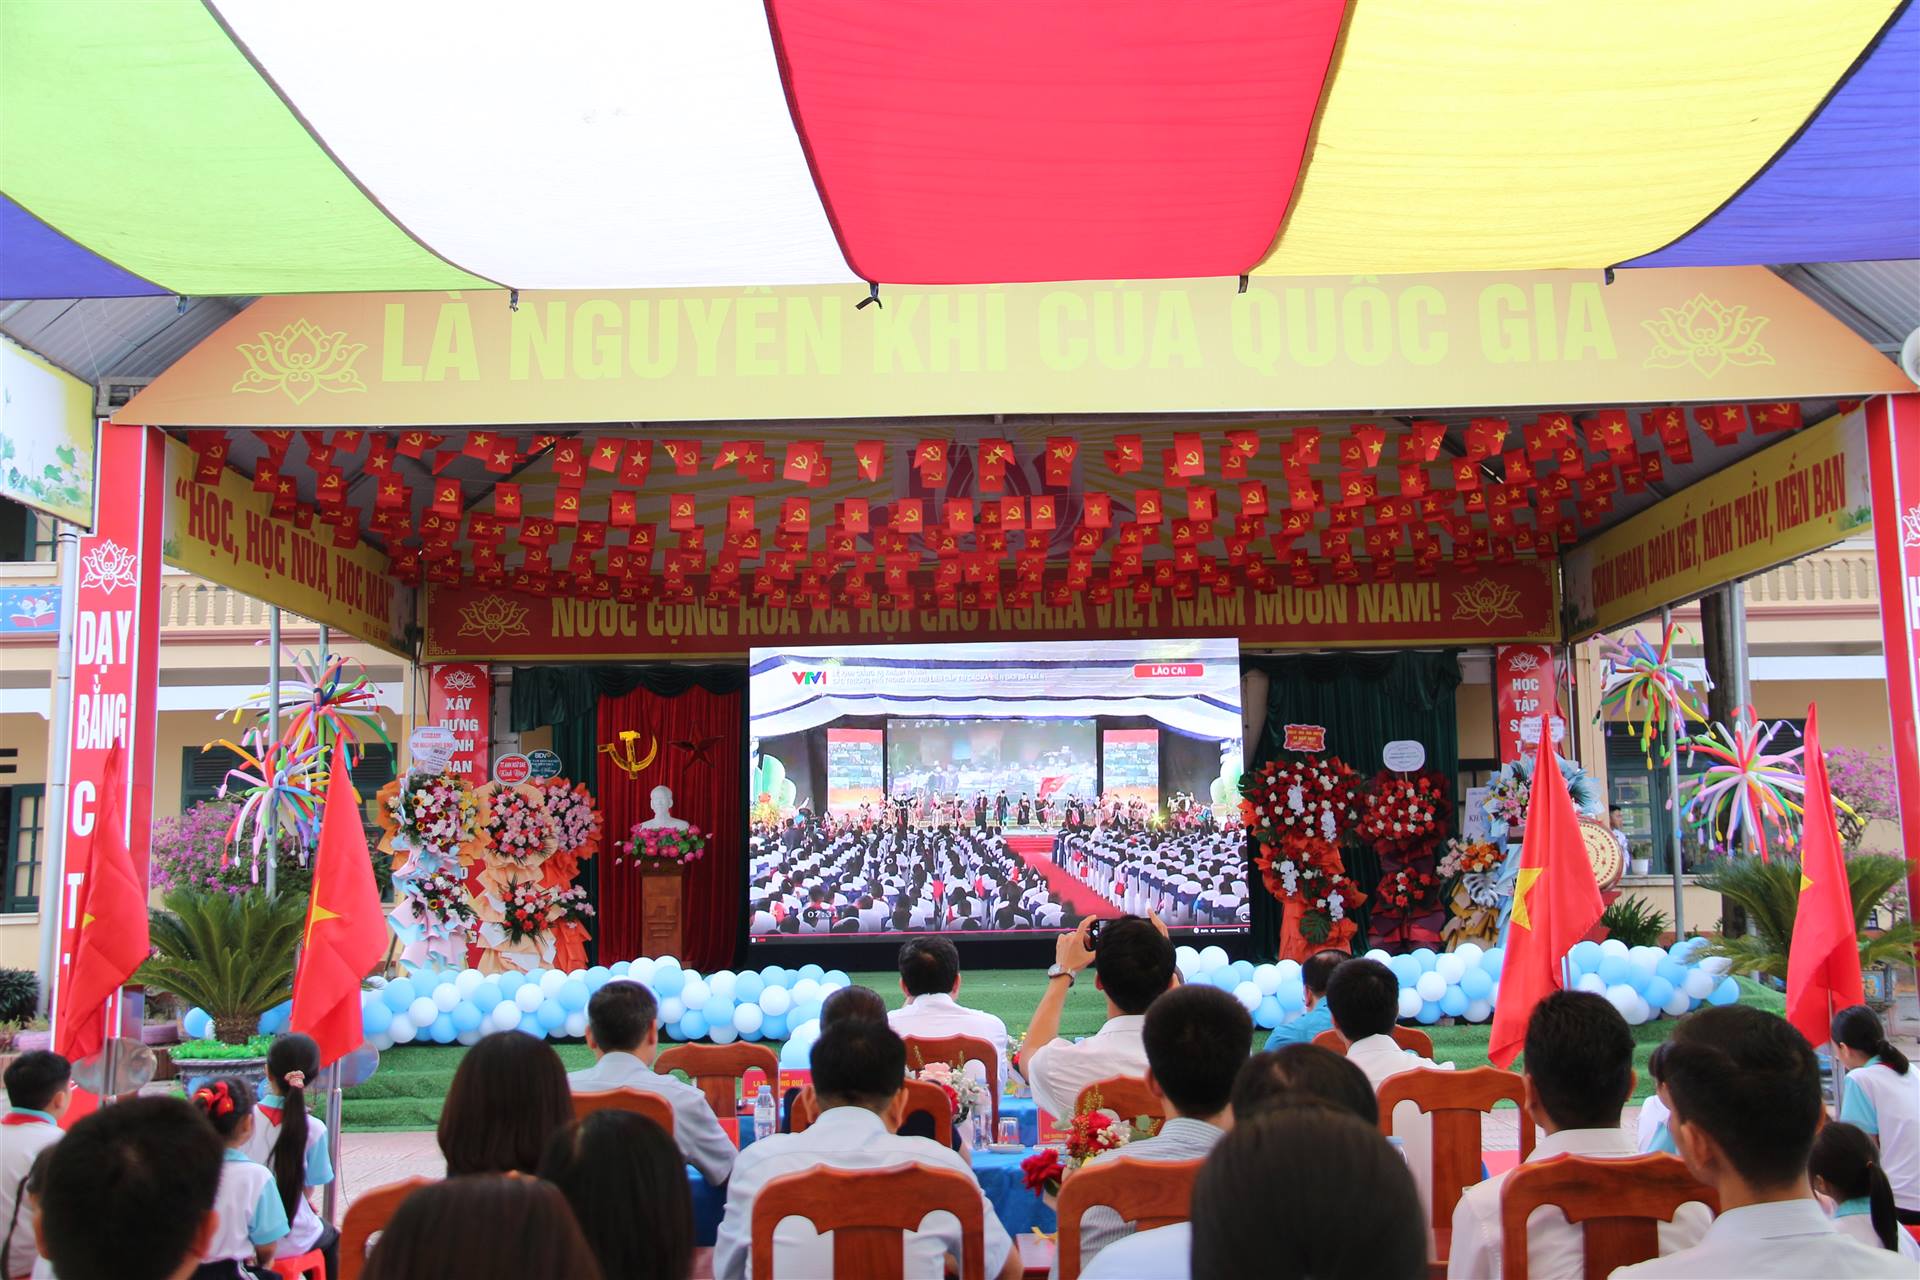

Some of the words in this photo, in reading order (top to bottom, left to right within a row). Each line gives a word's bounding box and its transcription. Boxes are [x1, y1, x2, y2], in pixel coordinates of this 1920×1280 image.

[382, 291, 481, 382] LÀ
[510, 286, 842, 381] NGUYÊN
[1478, 282, 1618, 364] GIA
[1702, 499, 1733, 562] KÍNH
[1812, 452, 1846, 524] BẠN
[246, 509, 286, 579] HỌC
[336, 554, 362, 614] HỌC
[1171, 586, 1246, 627] NAM
[79, 610, 132, 674] DẠY
[792, 671, 827, 685] VTV1
[1171, 666, 1186, 675] CAI
[1512, 678, 1539, 694] HỌC
[76, 675, 127, 750] BẰNG
[446, 695, 472, 710] XÂY
[1513, 696, 1539, 714] TẬP
